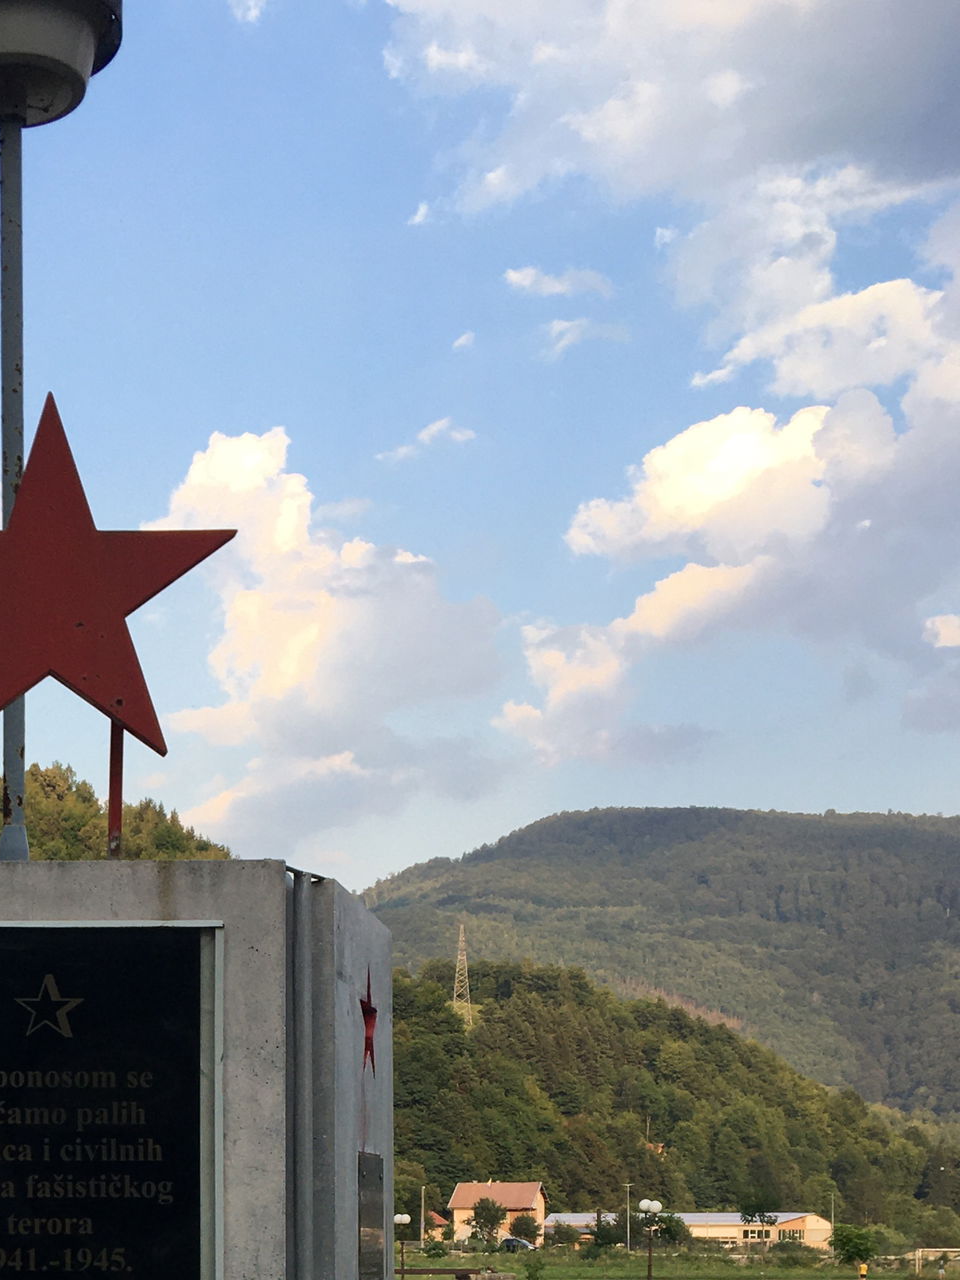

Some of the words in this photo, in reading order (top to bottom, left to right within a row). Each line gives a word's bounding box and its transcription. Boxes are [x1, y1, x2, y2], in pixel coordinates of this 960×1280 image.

[127, 1069, 154, 1088] se
[75, 1101, 146, 1132] palih
[43, 1137, 51, 1162] i
[60, 1137, 164, 1162] civilnih
[25, 1173, 174, 1205] fašističkog
[6, 1212, 94, 1235] terora
